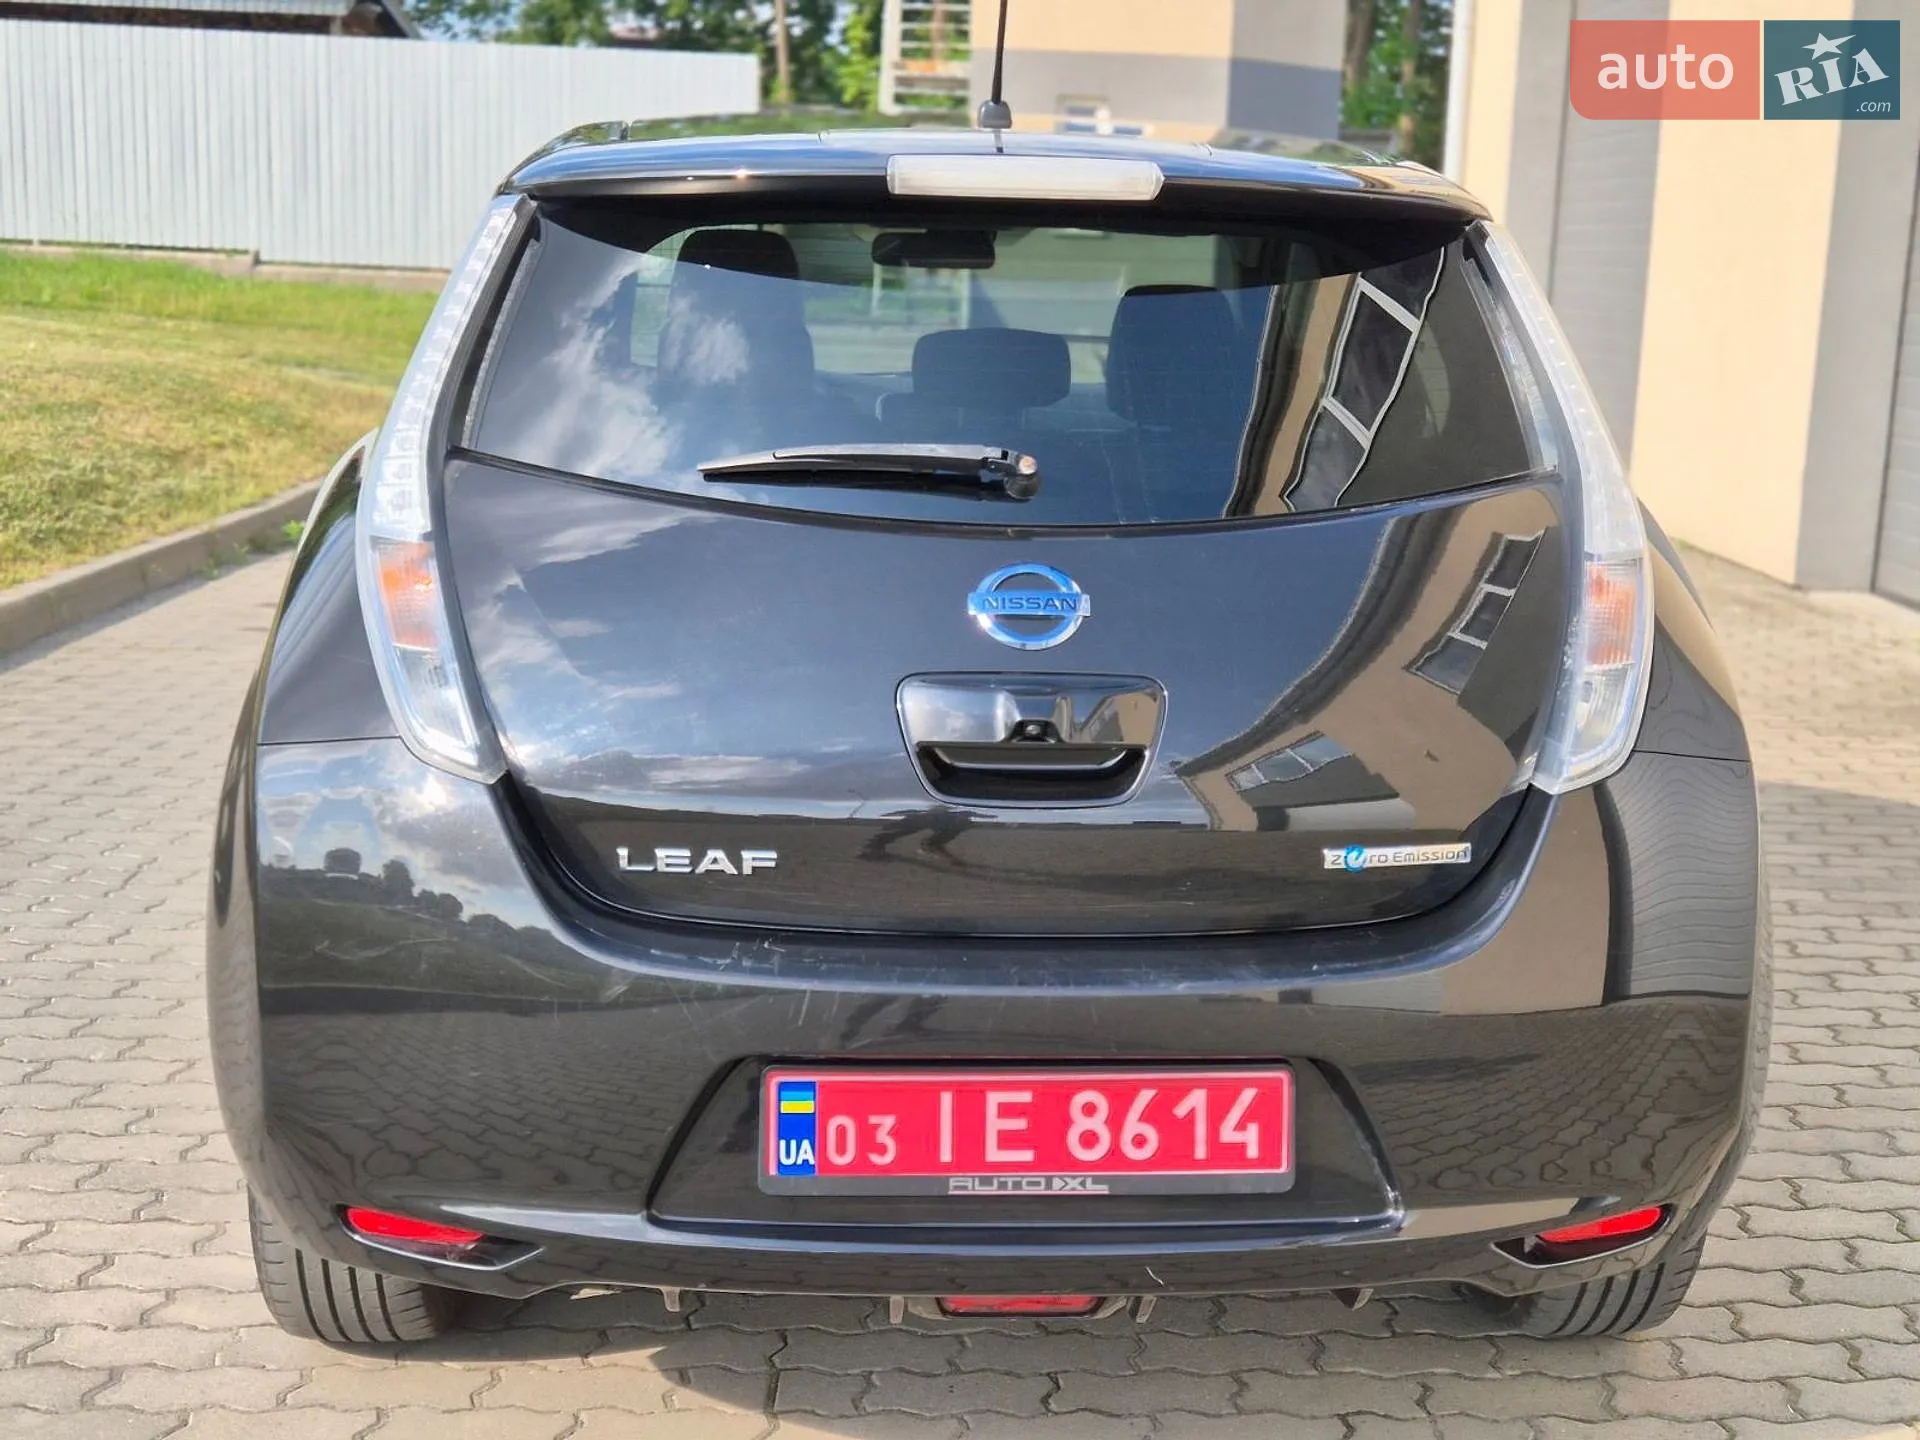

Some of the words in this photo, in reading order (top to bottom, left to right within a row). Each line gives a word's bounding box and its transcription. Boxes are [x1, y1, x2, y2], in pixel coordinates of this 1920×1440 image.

[982, 596, 1078, 611] NISSAN
[615, 846, 778, 875] LEAF
[1392, 846, 1468, 864] Emission
[826, 1115, 897, 1166] 03
[939, 1091, 1036, 1163] IE
[1066, 1087, 1260, 1162] 8614
[779, 1139, 815, 1165] UA
[949, 1177, 1046, 1191] AUTO
